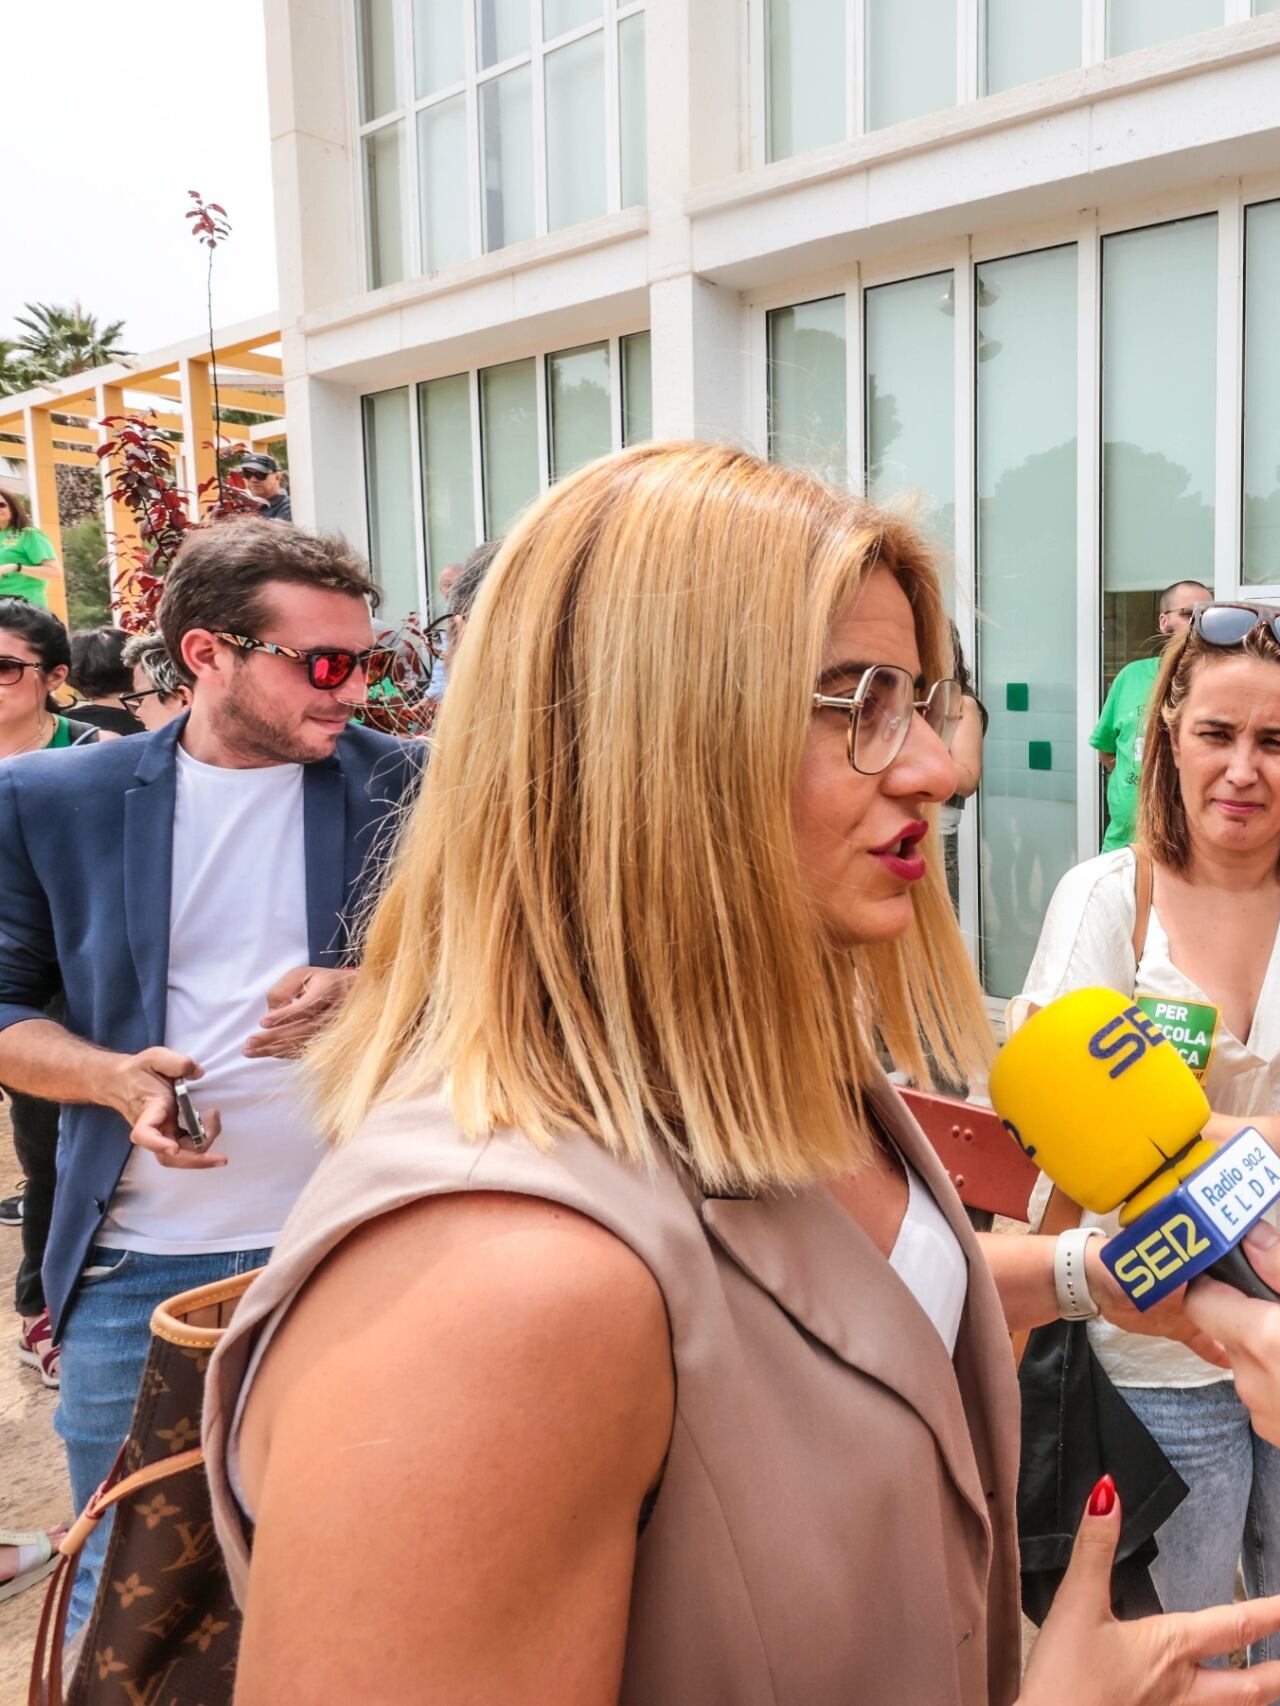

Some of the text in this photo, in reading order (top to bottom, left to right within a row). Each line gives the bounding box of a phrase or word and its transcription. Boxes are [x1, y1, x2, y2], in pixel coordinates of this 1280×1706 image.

[1154, 1003, 1188, 1022] PER
[1201, 1146, 1266, 1207] Radio 90.2
[1114, 1213, 1211, 1298] SER
